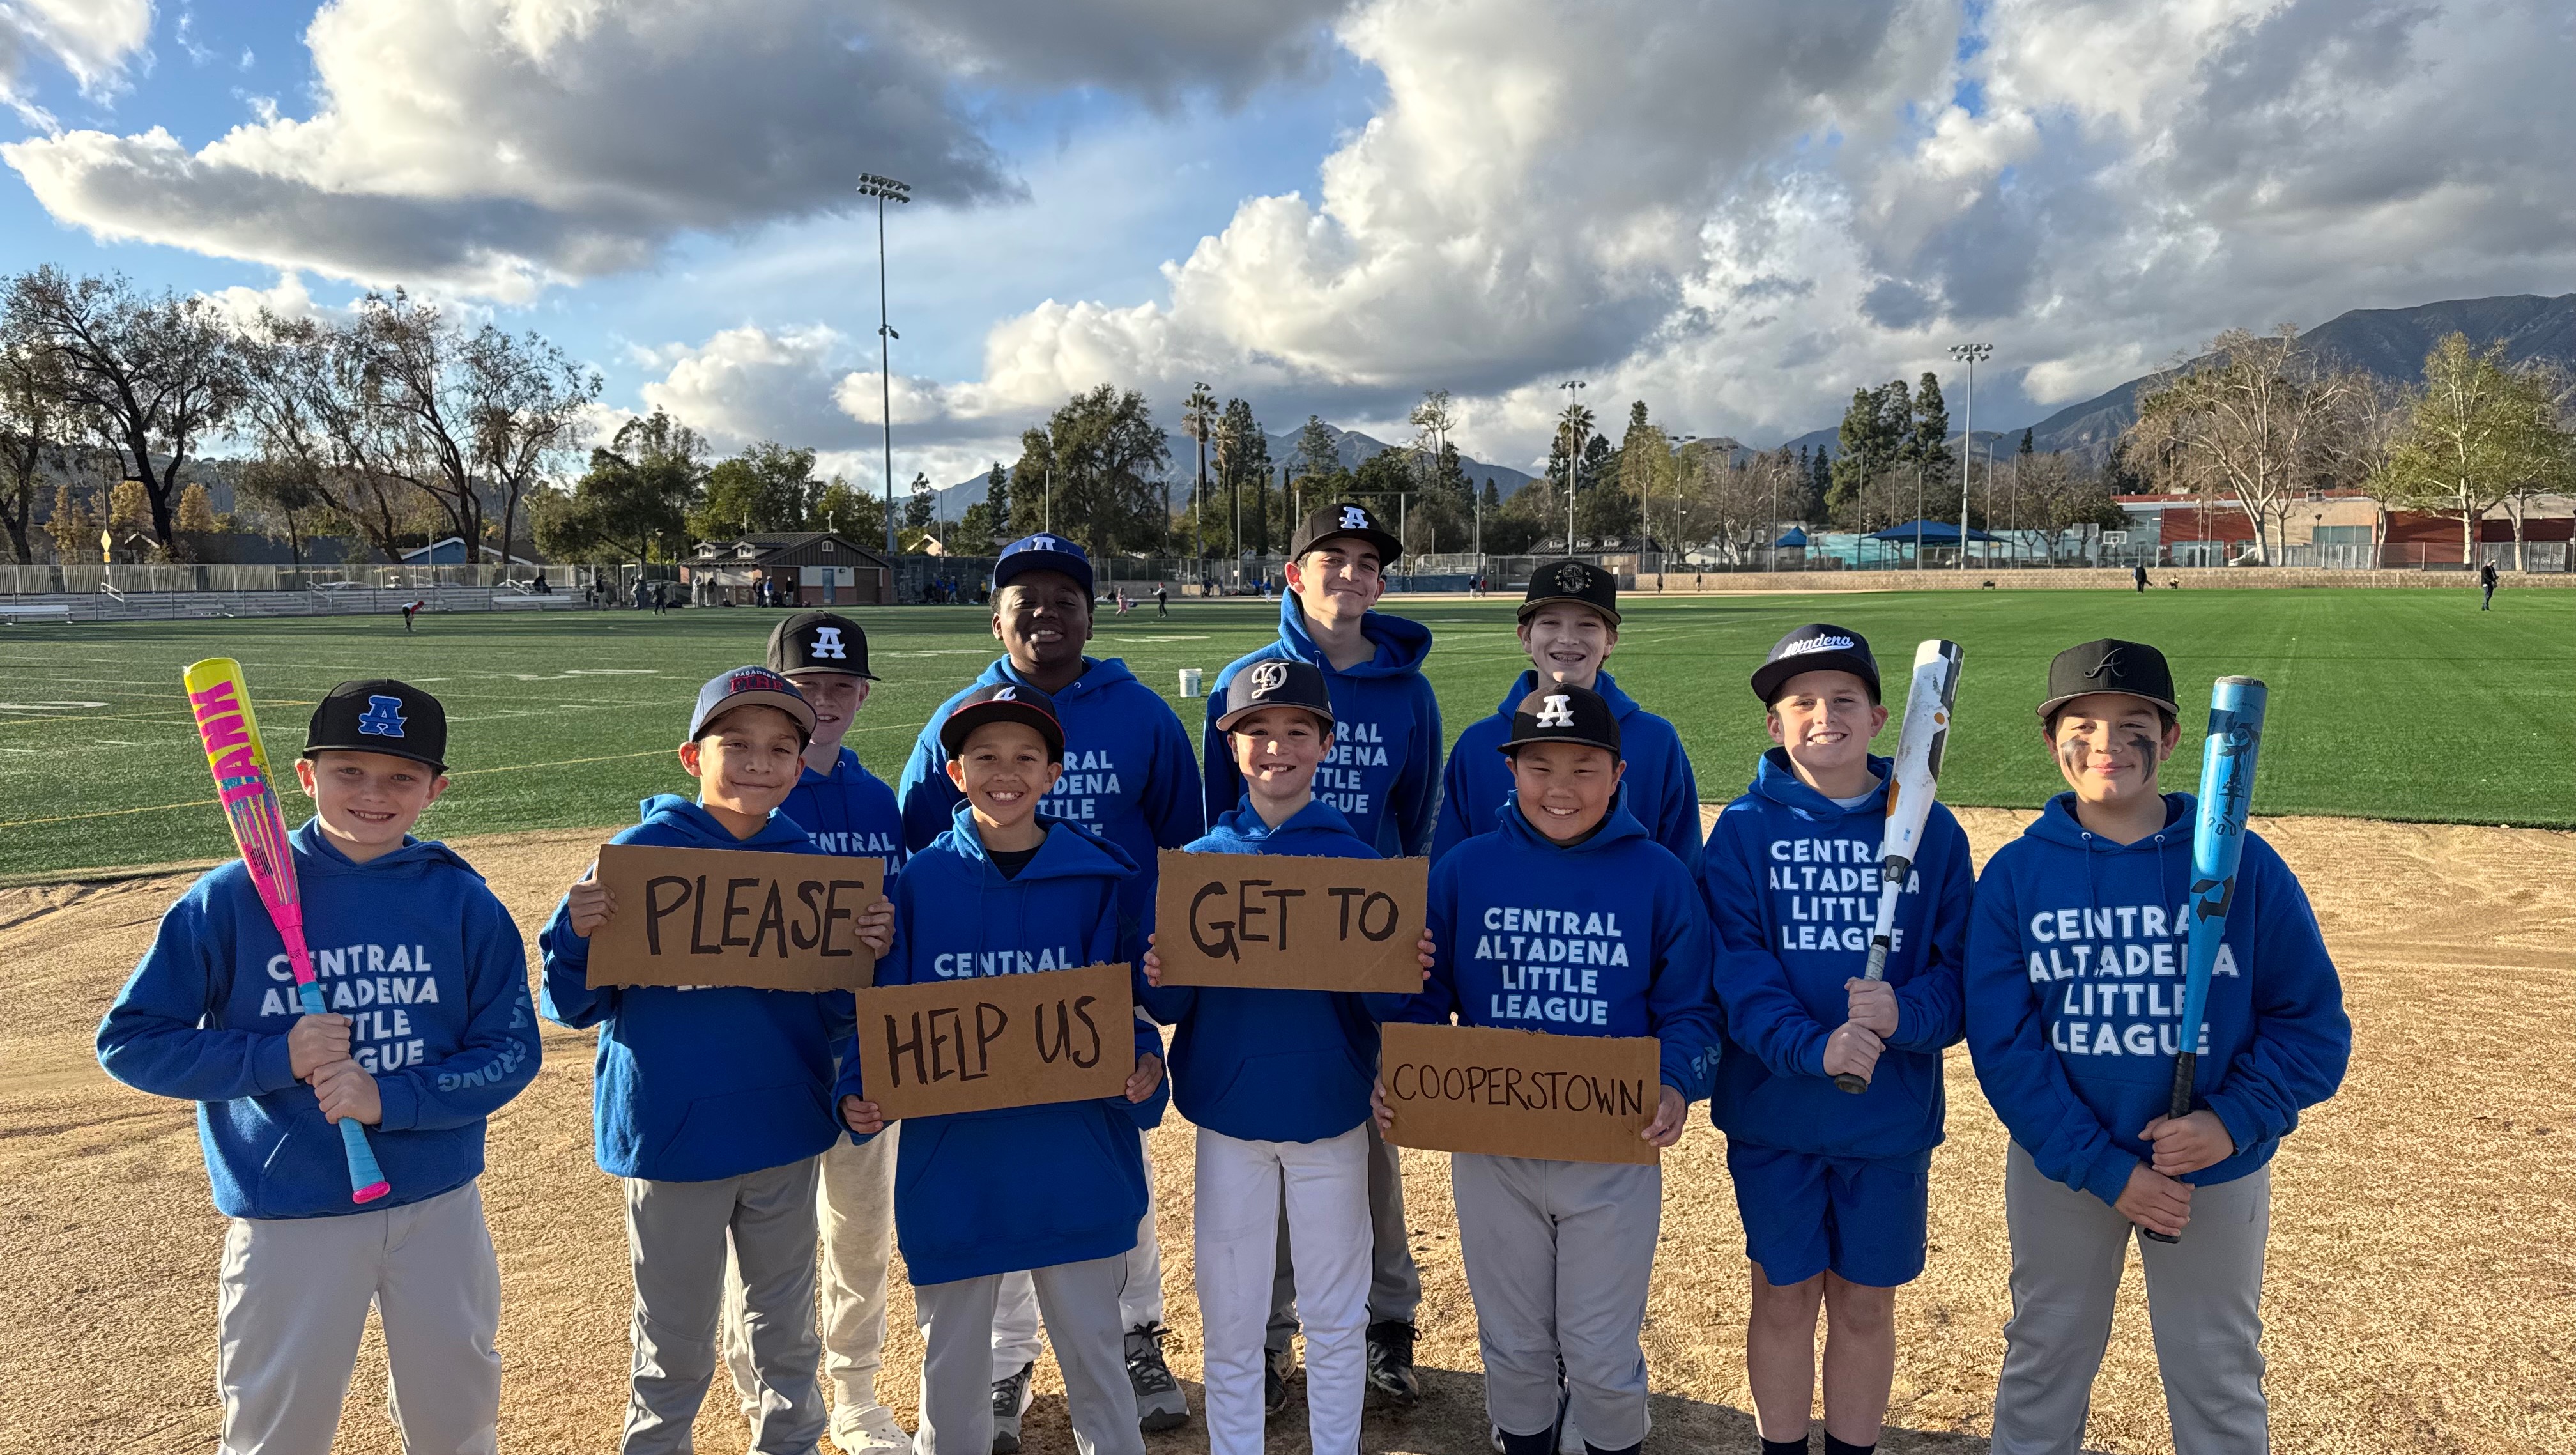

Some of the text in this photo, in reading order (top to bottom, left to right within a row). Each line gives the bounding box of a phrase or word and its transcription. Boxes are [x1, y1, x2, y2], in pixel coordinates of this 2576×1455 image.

[1339, 507, 1369, 529] A
[811, 627, 846, 659] A
[735, 670, 777, 680] PASADENA
[358, 695, 408, 737] A
[1536, 695, 1575, 728] A
[1052, 773, 1121, 795] DENA
[1036, 799, 1096, 820] TTLE
[646, 875, 864, 958] PLEASE
[1189, 879, 1399, 964] GET TO
[1483, 906, 1623, 938] CENTRAL
[933, 946, 1073, 978] CENTRAL
[1474, 935, 1629, 967] ALTADENA
[1501, 964, 1598, 995] LITTLE
[259, 976, 440, 1017] ALADENA
[1490, 994, 1609, 1026] LEAGUE
[353, 1038, 425, 1074] GUE
[884, 996, 1100, 1088] HELP US
[1393, 1063, 1643, 1116] COOPERSTOWN
